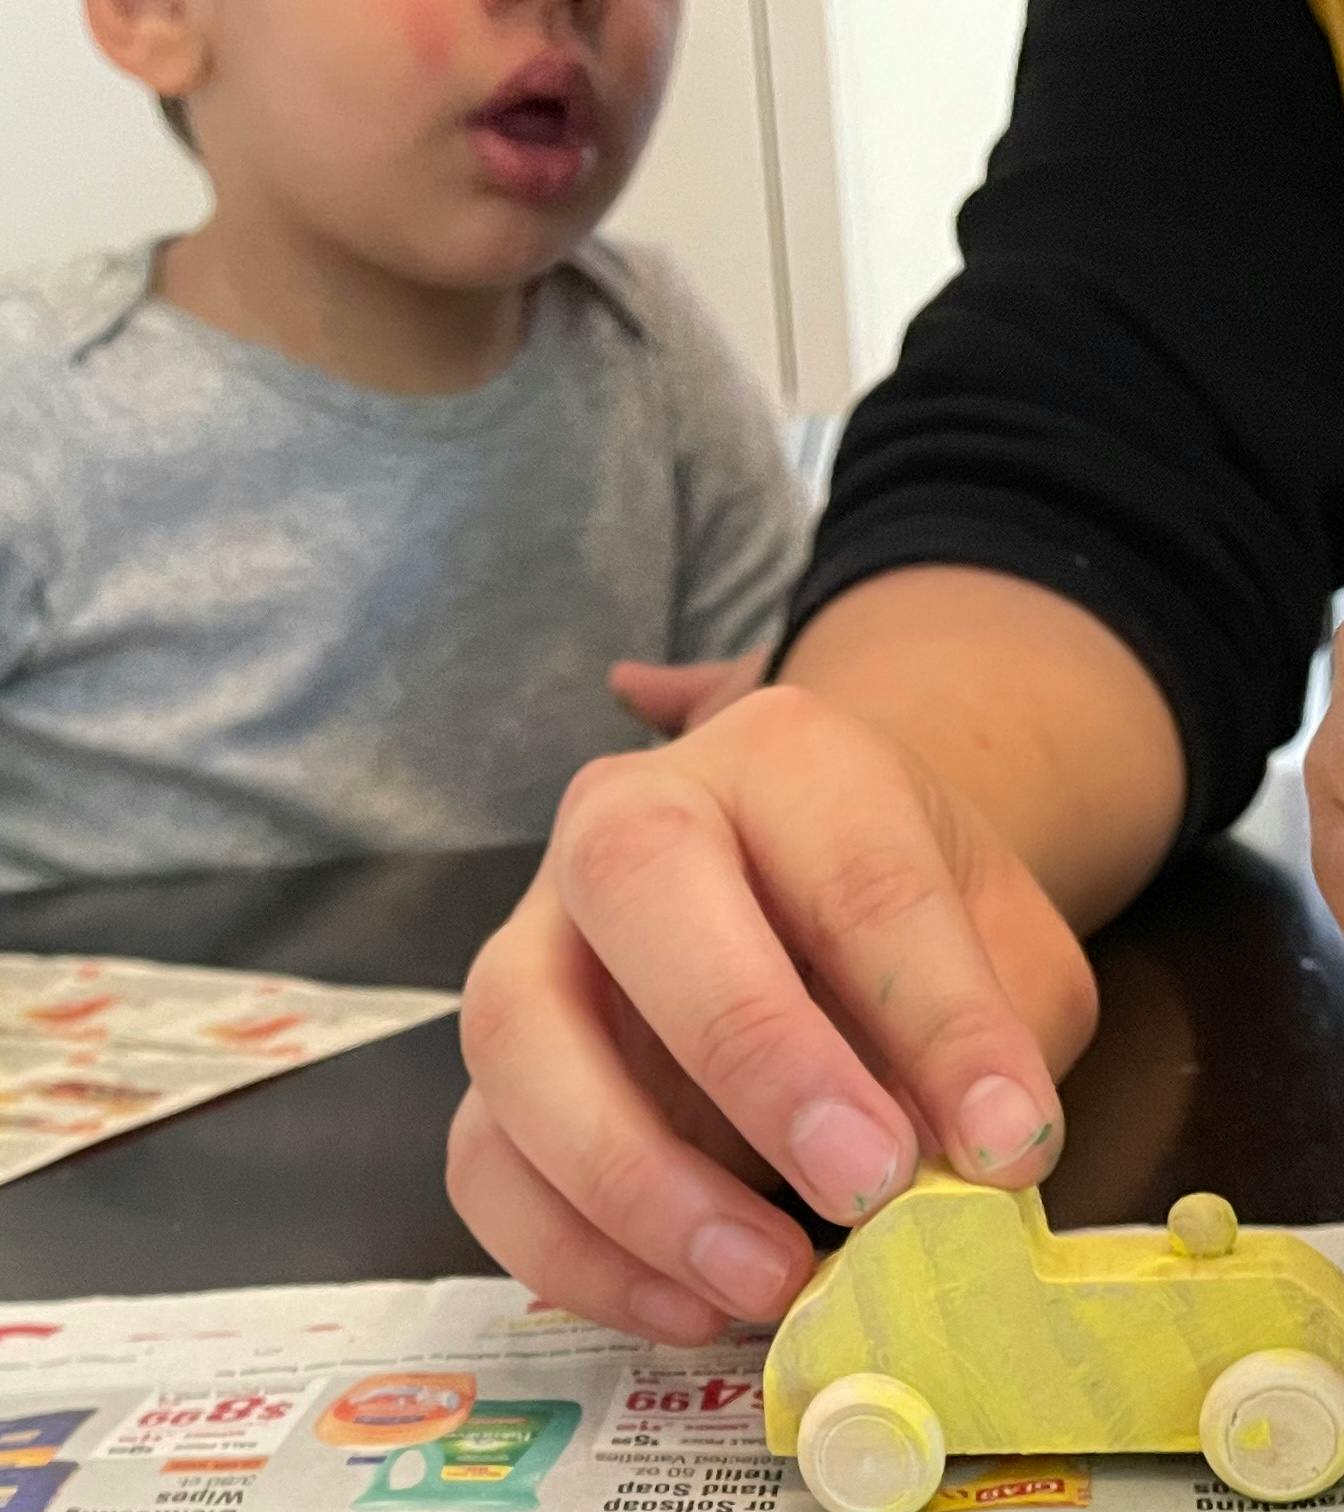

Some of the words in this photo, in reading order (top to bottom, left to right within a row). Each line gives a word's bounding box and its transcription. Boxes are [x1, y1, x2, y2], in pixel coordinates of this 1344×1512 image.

[617, 1482, 691, 1496] Soap
[702, 1483, 780, 1496] Hand
[976, 1481, 1059, 1500] GLAD
[156, 1489, 244, 1505] Wipes
[745, 1501, 776, 1512] or
